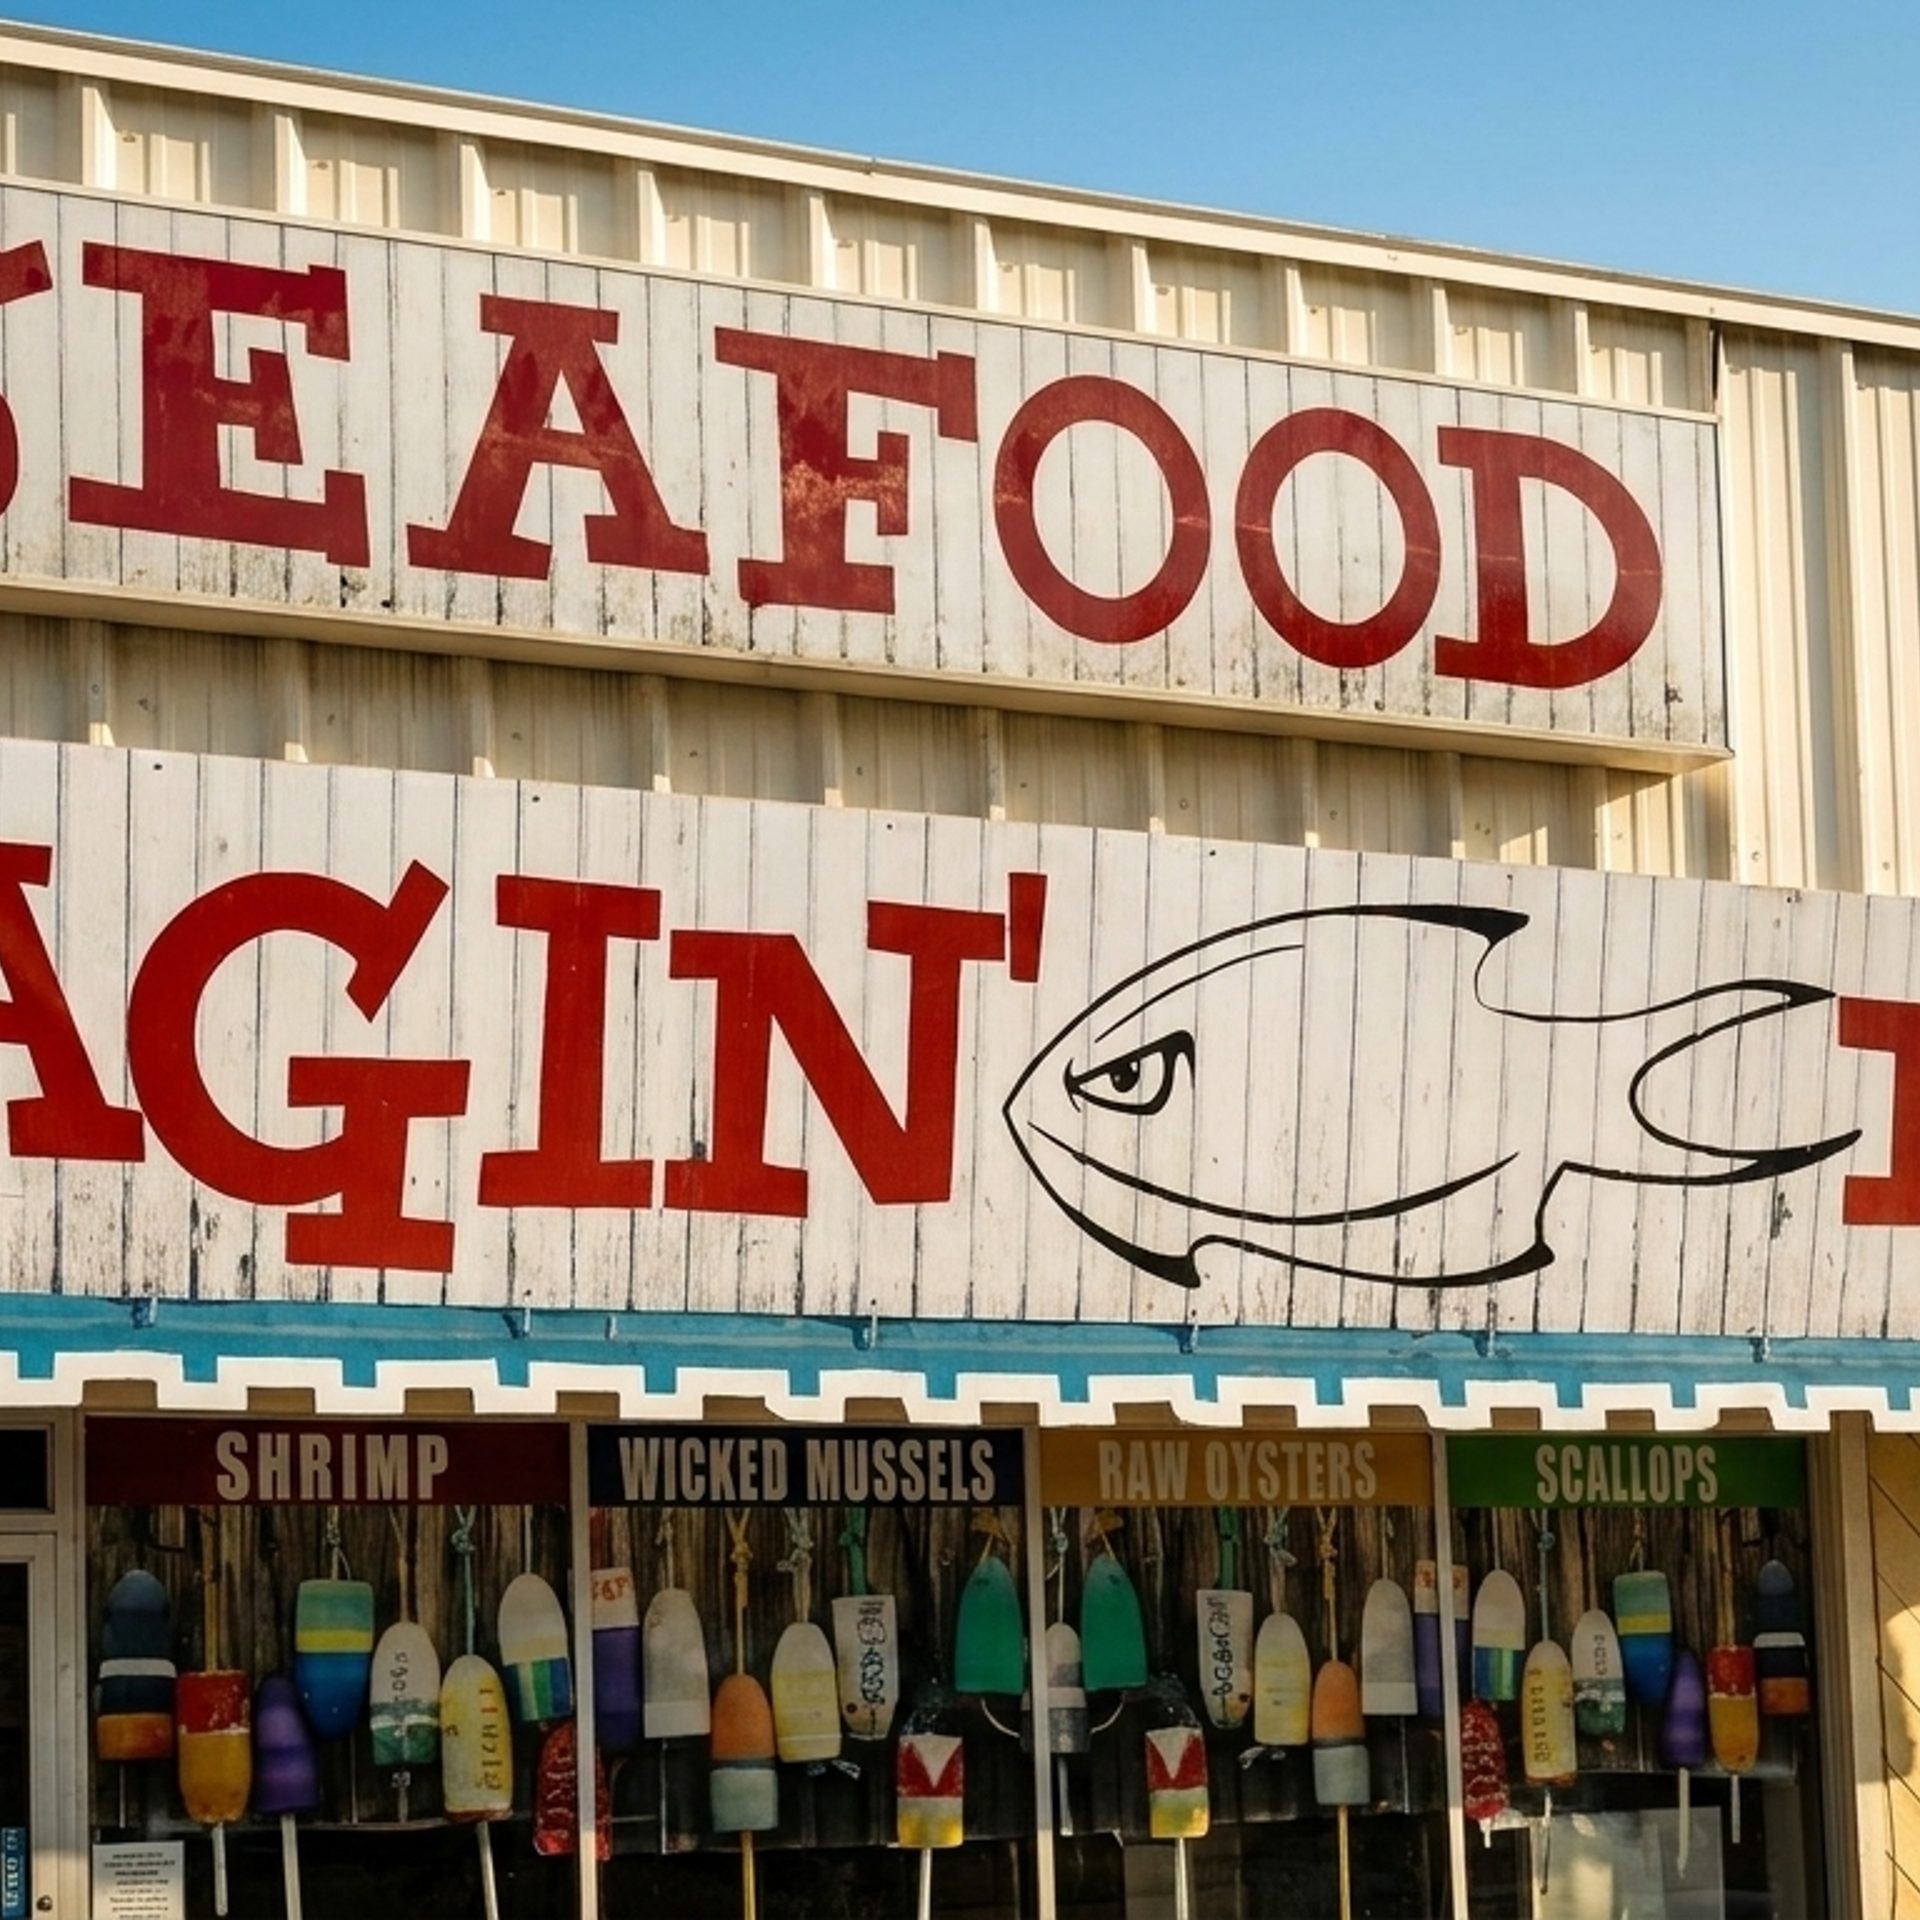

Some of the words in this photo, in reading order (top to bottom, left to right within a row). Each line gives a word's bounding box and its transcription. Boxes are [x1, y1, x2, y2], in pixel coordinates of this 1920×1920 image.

[216, 1430, 449, 1501] SHRIMP
[618, 1437, 788, 1501] WICKED
[806, 1438, 995, 1502] MUSSELS
[1098, 1440, 1189, 1501] RAW
[1204, 1440, 1377, 1501] OYSTERS
[1535, 1444, 1718, 1503] SCALLOPS
